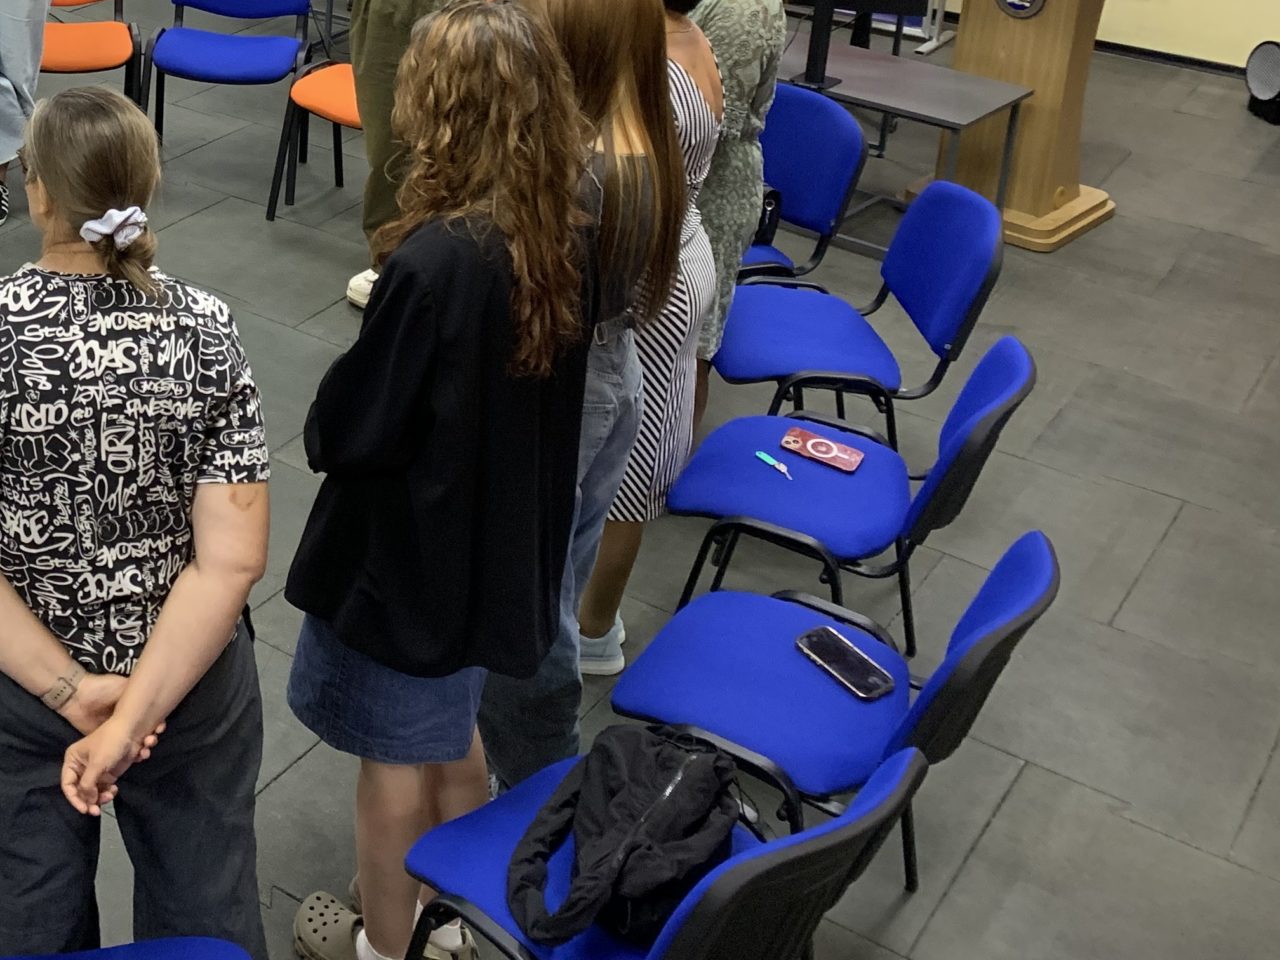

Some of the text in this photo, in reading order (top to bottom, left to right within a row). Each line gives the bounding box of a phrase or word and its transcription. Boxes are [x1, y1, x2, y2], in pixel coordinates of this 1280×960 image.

[186, 284, 229, 323] SPAC
[213, 448, 269, 470] AWESO
[21, 476, 44, 492] IS
